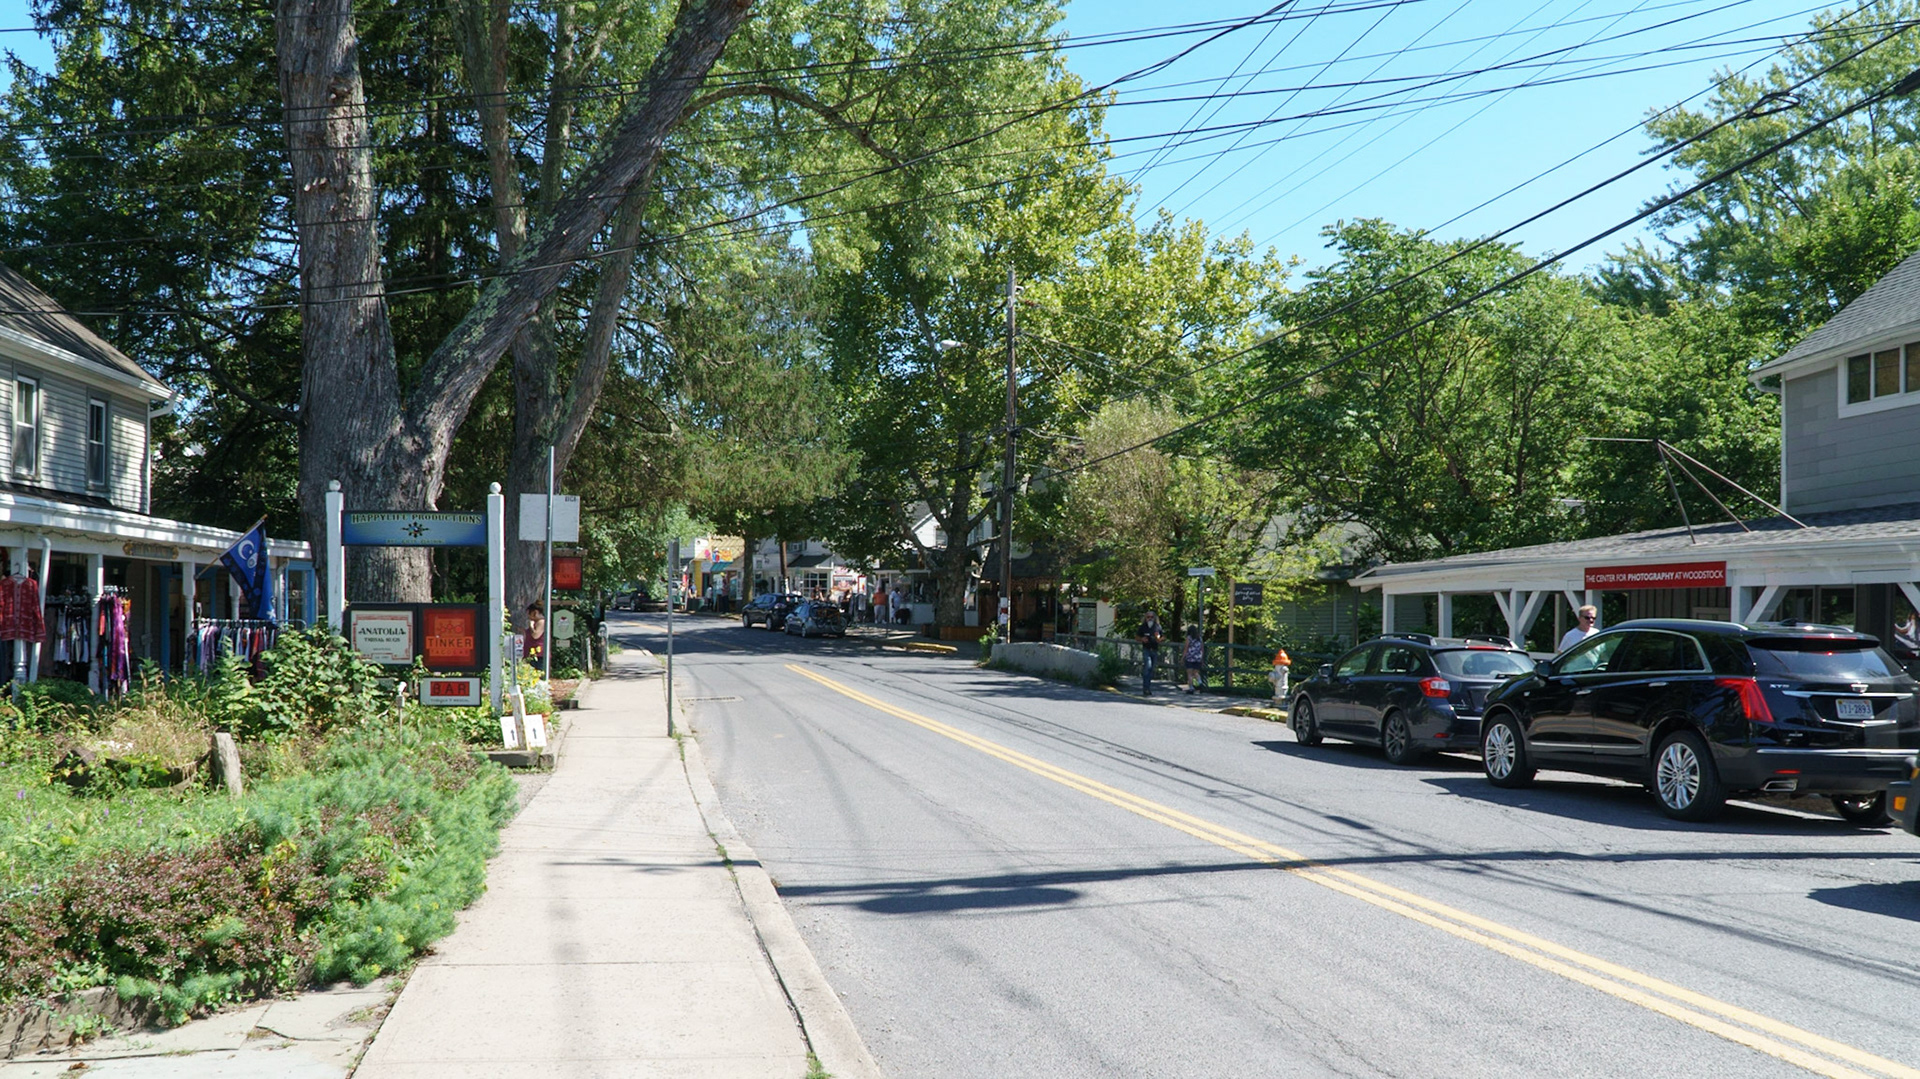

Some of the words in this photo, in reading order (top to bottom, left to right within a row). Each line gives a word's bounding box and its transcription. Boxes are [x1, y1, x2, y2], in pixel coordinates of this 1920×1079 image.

[351, 513, 407, 524] HAPPYLIFE
[411, 513, 482, 525] PRODUCTIONS
[1586, 574, 1596, 582] THE
[1596, 573, 1615, 582] CENTER
[1616, 573, 1627, 582] FOR
[1628, 571, 1674, 581] PHOTOGRAPHY
[1675, 571, 1682, 580] AT
[1683, 570, 1724, 580] WOODSTOCK
[358, 627, 406, 636] ANATOLIA
[428, 637, 472, 648] TINKER
[433, 682, 467, 696] BAR
